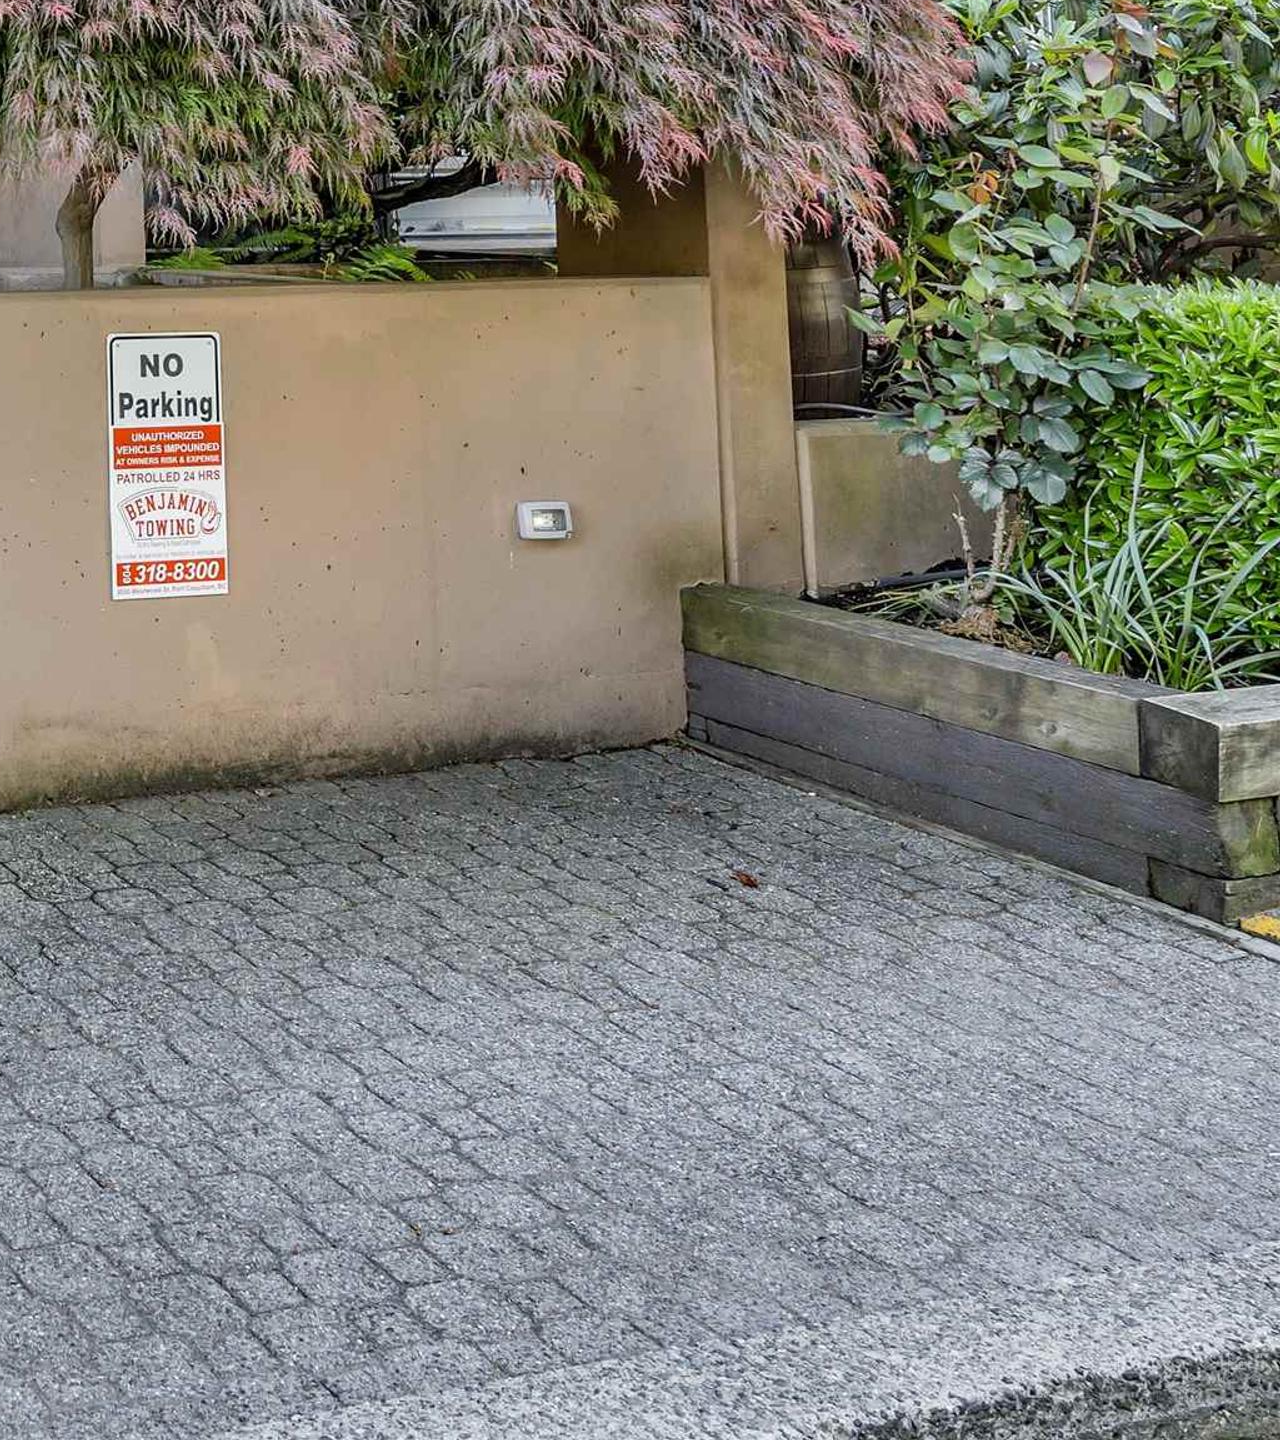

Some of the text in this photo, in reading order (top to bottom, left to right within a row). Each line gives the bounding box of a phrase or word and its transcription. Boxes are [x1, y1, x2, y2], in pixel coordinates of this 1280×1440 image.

[140, 353, 183, 377] NO
[119, 392, 212, 422] Parking
[131, 431, 204, 442] UNAUTHORIZED
[115, 442, 220, 455] VEHICLES IMPOUNDED
[117, 470, 220, 484] PATROLLED 24 HRS
[125, 492, 207, 520] BENJAMIN
[135, 518, 196, 537] TOWING
[134, 561, 219, 583] 318-8300
